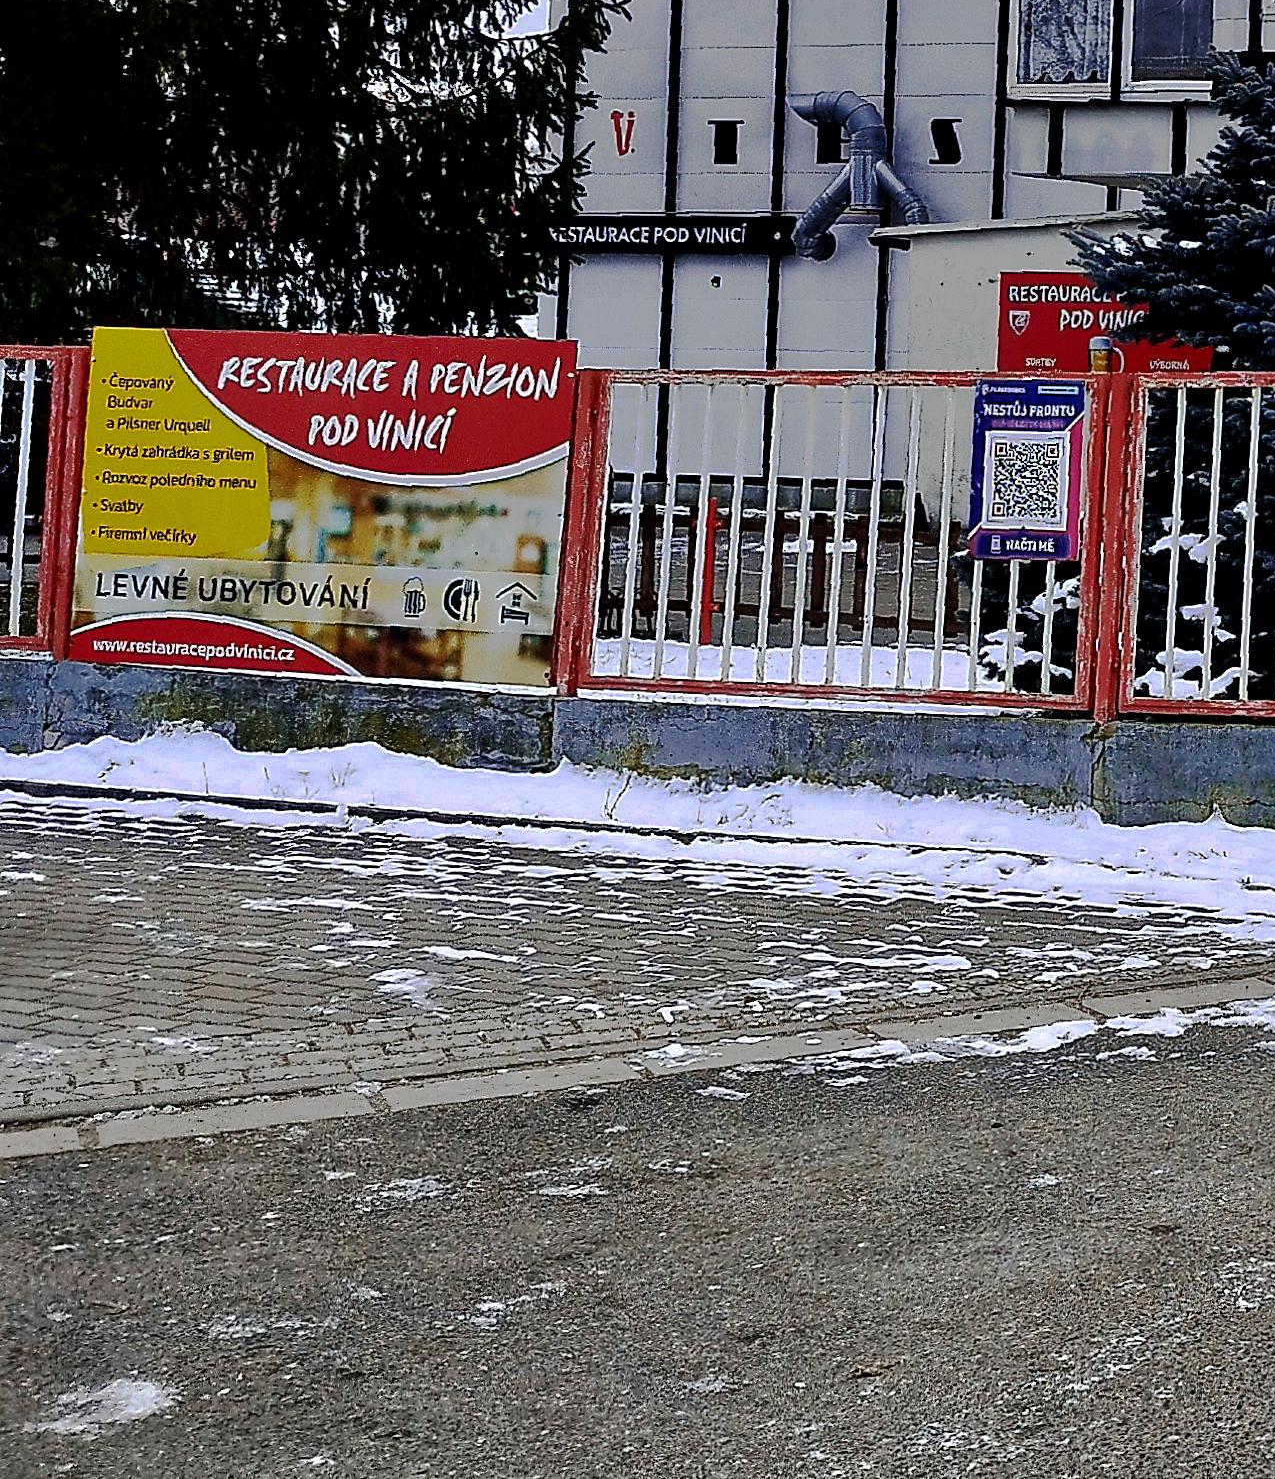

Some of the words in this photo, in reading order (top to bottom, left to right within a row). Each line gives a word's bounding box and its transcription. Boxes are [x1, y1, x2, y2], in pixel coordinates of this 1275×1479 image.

[653, 226, 689, 244] POD
[694, 223, 747, 244] VINICÍ
[1059, 309, 1094, 332] POD
[1099, 309, 1147, 332] VINIC
[109, 372, 174, 391] Čepovaný
[217, 355, 397, 398] RESTAURACE
[401, 358, 419, 400] A
[430, 355, 562, 400] PENZION
[107, 395, 153, 409] Budvar
[983, 400, 1028, 417] NESTŮJ
[106, 419, 115, 429] a
[117, 417, 161, 431] Pilsner
[164, 418, 211, 435] Urquell
[308, 414, 359, 447] POD
[367, 407, 457, 454] VINICÍ
[104, 443, 139, 460] Krytá
[141, 445, 200, 460] zahrádka
[203, 451, 210, 460] s
[212, 446, 255, 463] grilem
[102, 471, 147, 485] Rozvoz
[150, 473, 216, 489] poledního
[219, 478, 257, 489] menu
[100, 499, 144, 515] Svatby
[98, 525, 147, 541] Firemní
[149, 528, 197, 546] večírky
[1005, 537, 1037, 552] NAČTI
[1038, 537, 1055, 553] MĚ
[95, 568, 189, 601] LEVNÉ
[198, 574, 371, 610] UBYTOVÁNÍ
[92, 638, 295, 661] www.restauracepodvinici.cz
